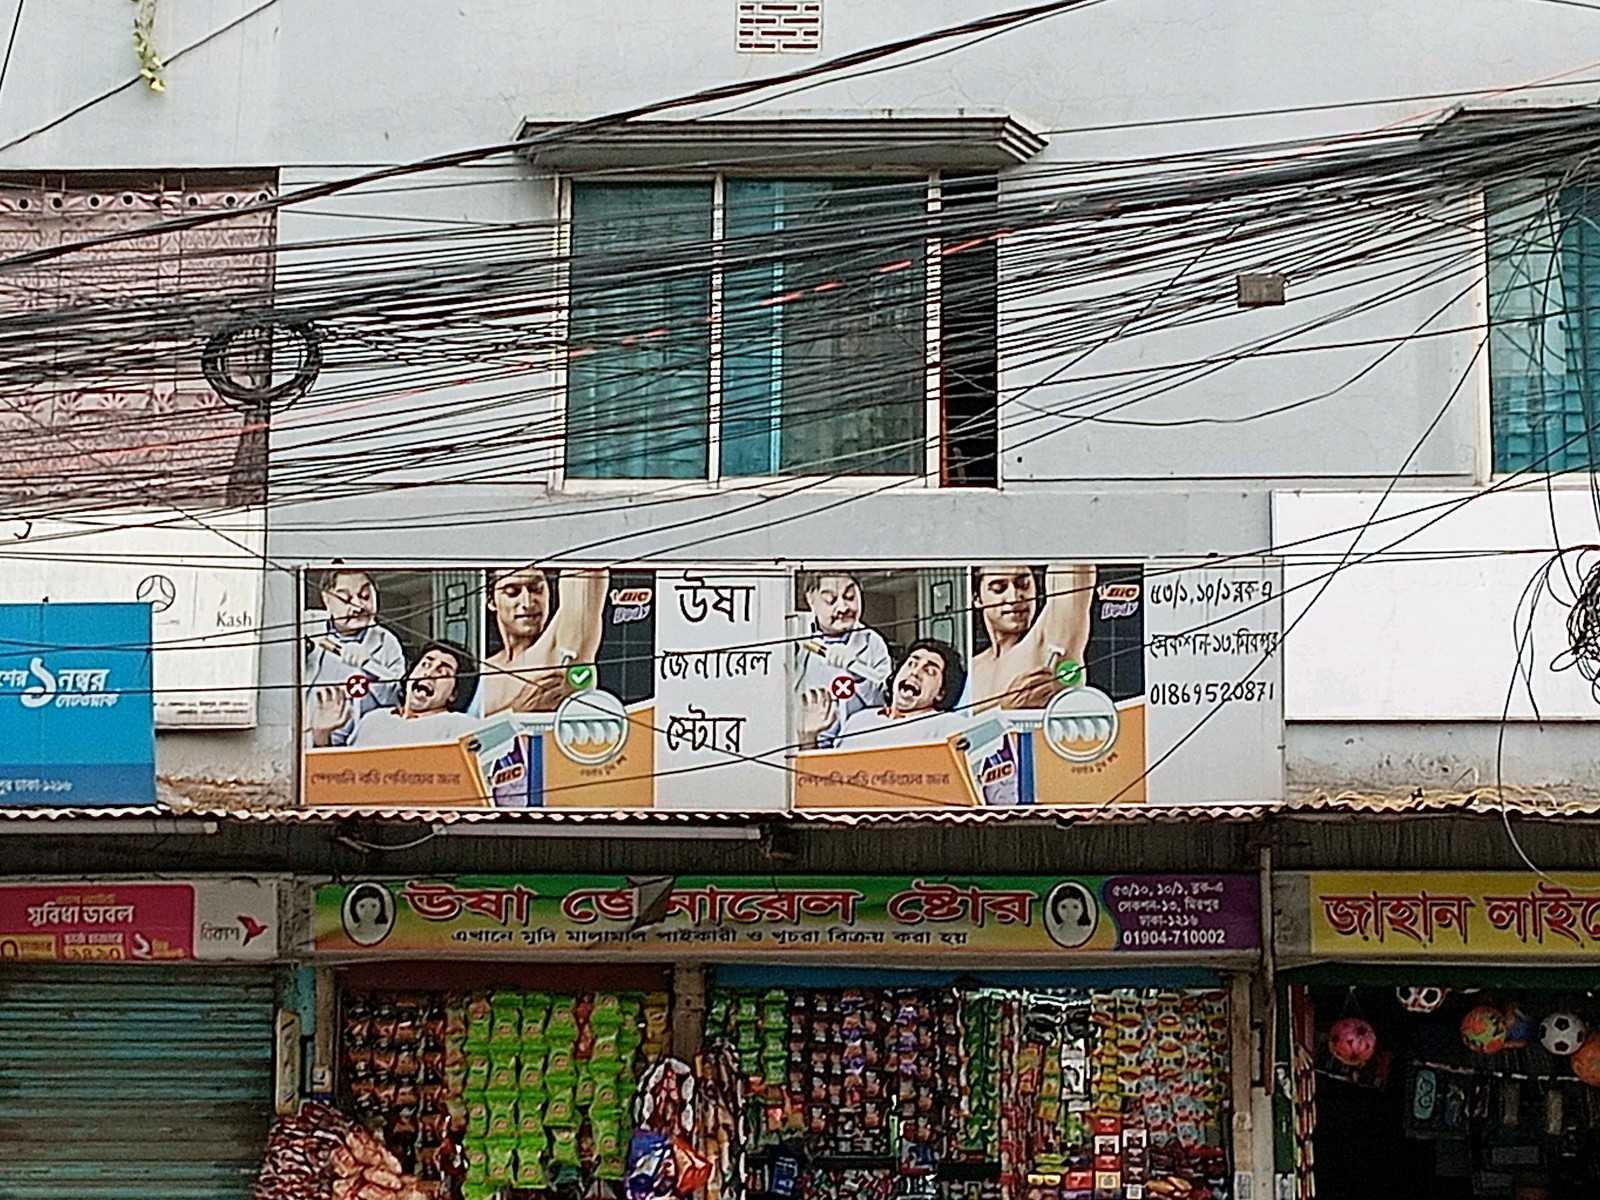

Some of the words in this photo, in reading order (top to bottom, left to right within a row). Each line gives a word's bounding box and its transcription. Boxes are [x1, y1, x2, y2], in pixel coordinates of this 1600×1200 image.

[675, 569, 755, 623] উষা
[660, 650, 772, 679] জেনারেল
[1150, 681, 1275, 705] 01869520871
[666, 703, 747, 753] স্টোর
[28, 902, 79, 927] সুবিধা
[82, 905, 135, 924] ডাবল
[400, 881, 537, 926] উষা
[201, 922, 240, 940] বিকাশ
[1318, 890, 1476, 948] জাহান
[451, 929, 513, 943] এখানে
[522, 927, 556, 945] মুদি
[747, 930, 763, 942] ও
[894, 930, 931, 944] করা
[1123, 929, 1226, 945] 01904-710002
